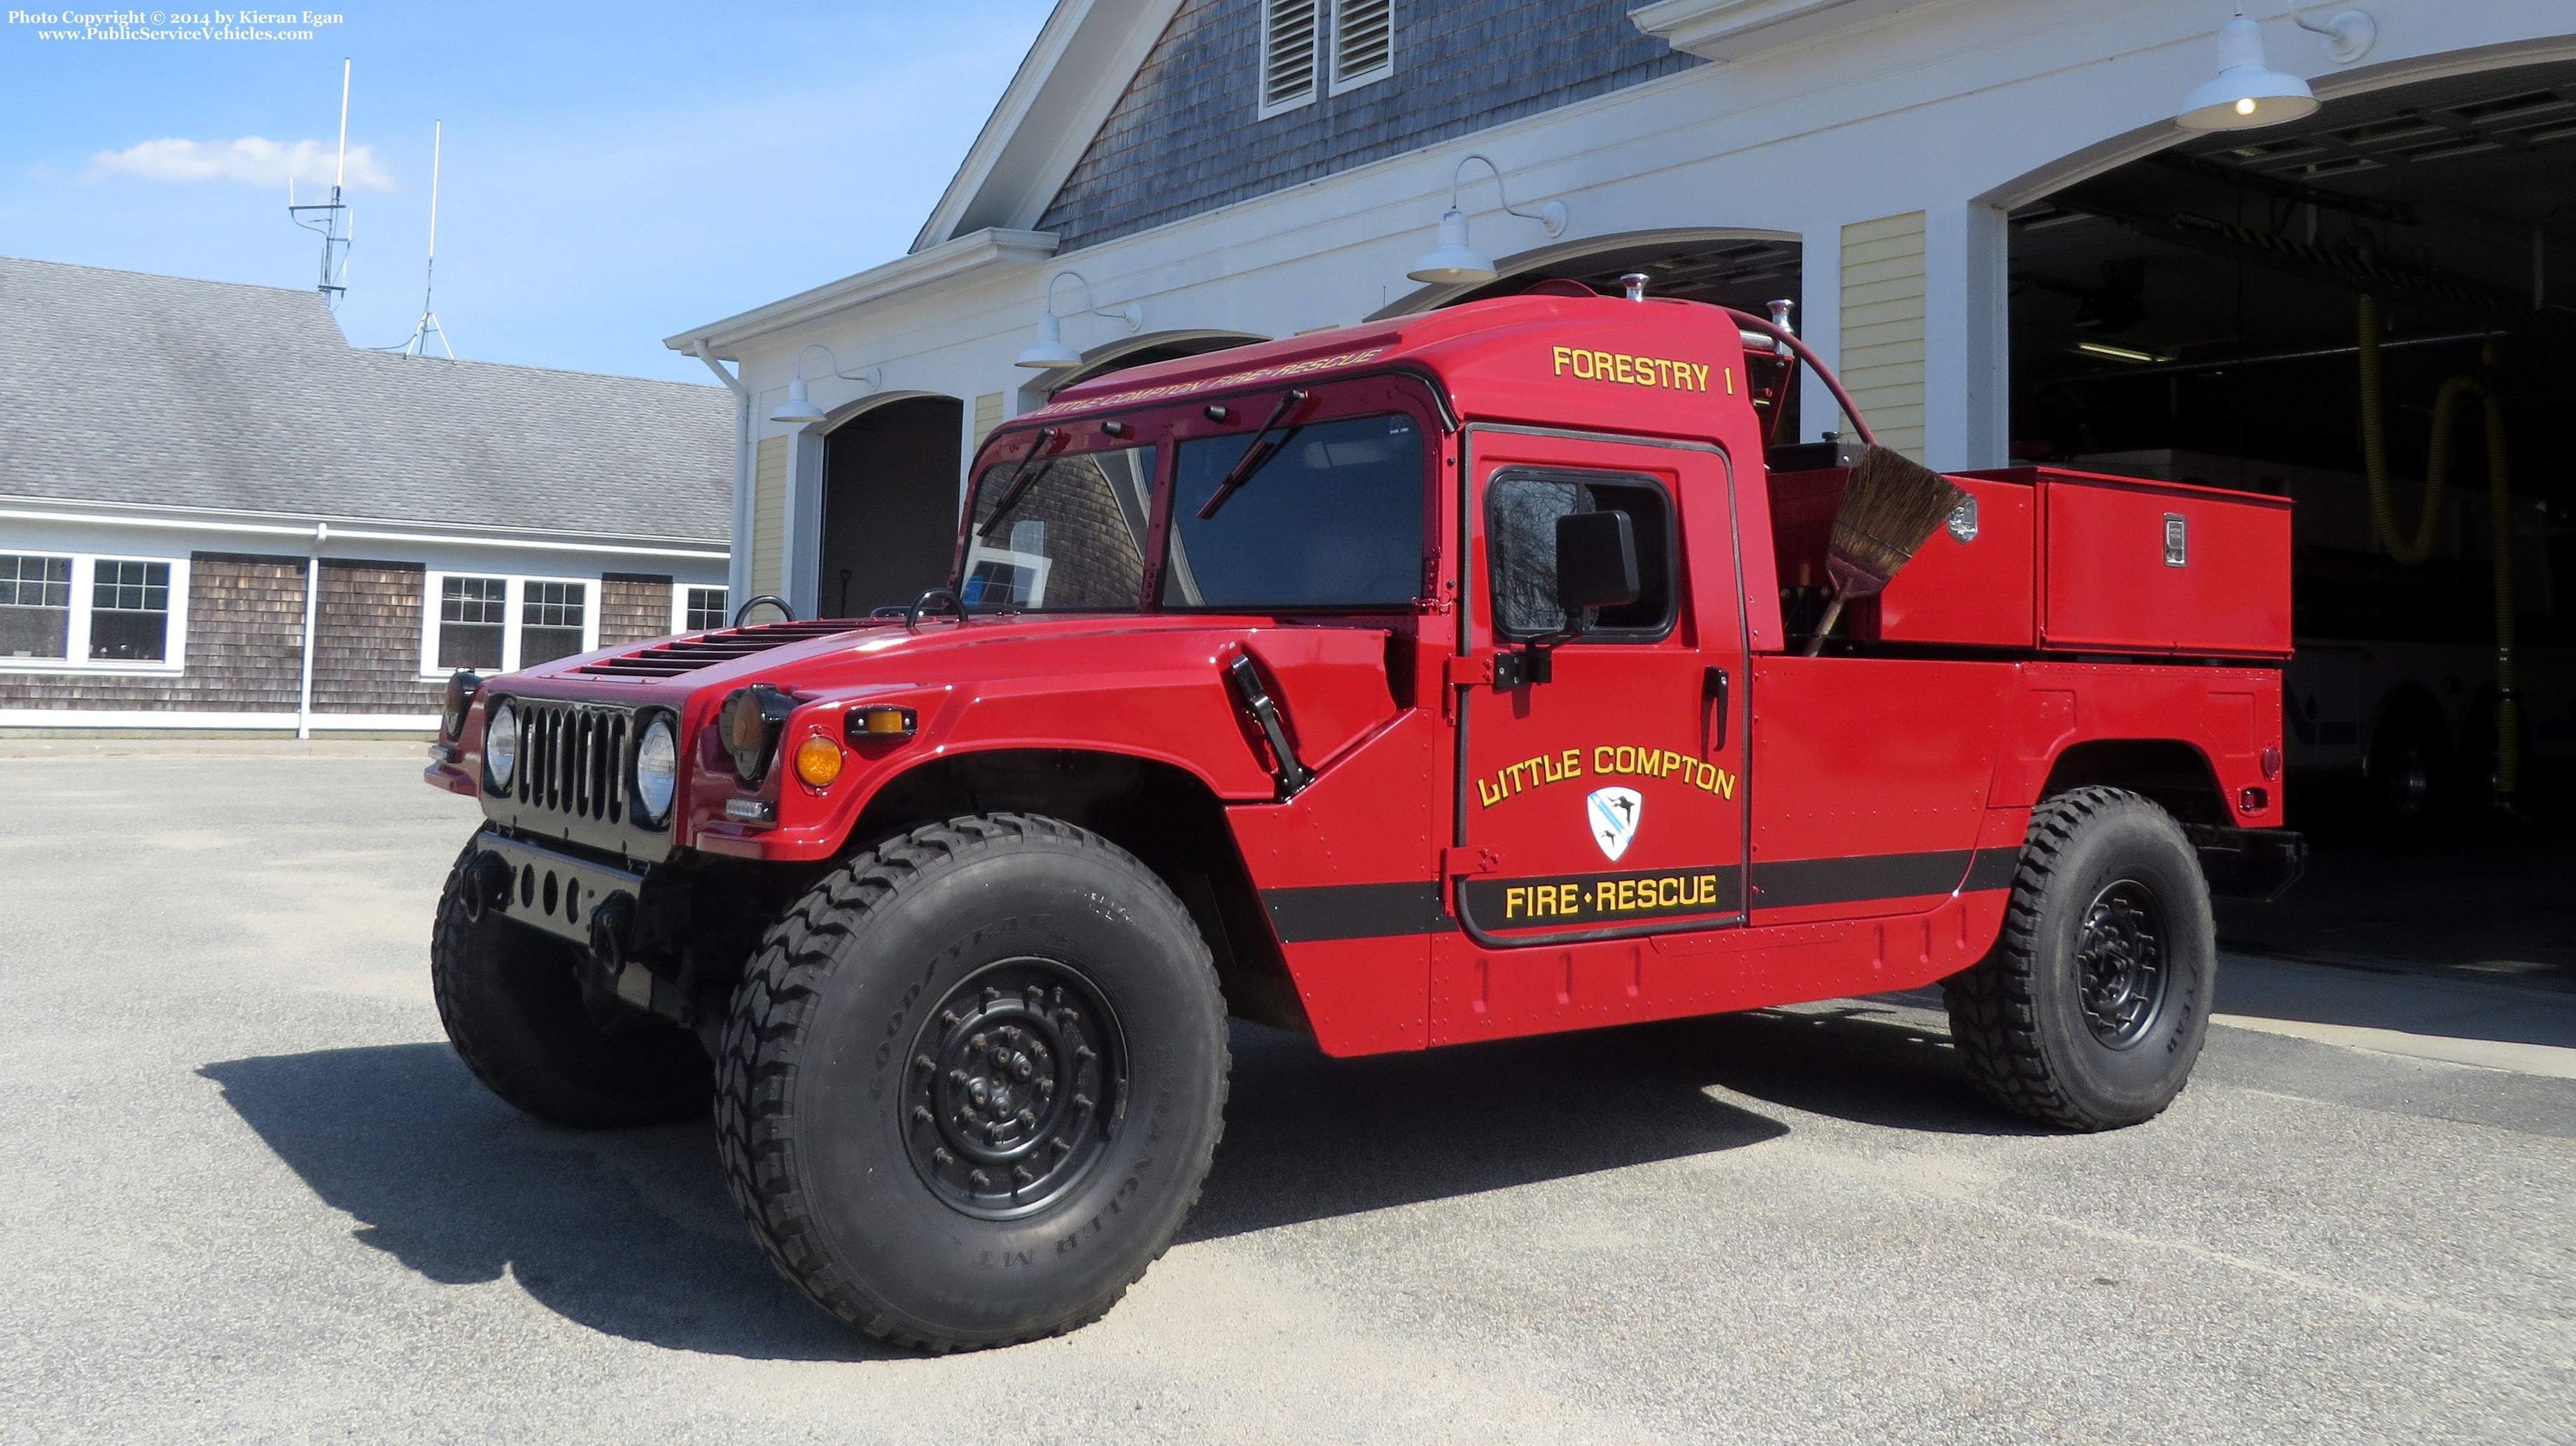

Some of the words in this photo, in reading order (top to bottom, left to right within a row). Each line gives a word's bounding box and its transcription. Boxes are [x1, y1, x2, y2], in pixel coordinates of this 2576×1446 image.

[1552, 346, 1709, 392] FORESTRY
[1037, 397, 1103, 416] LITTLE
[1100, 380, 1208, 406] COMPTON
[1477, 749, 1582, 809] LITTLE
[1593, 745, 1736, 800] COMPTON
